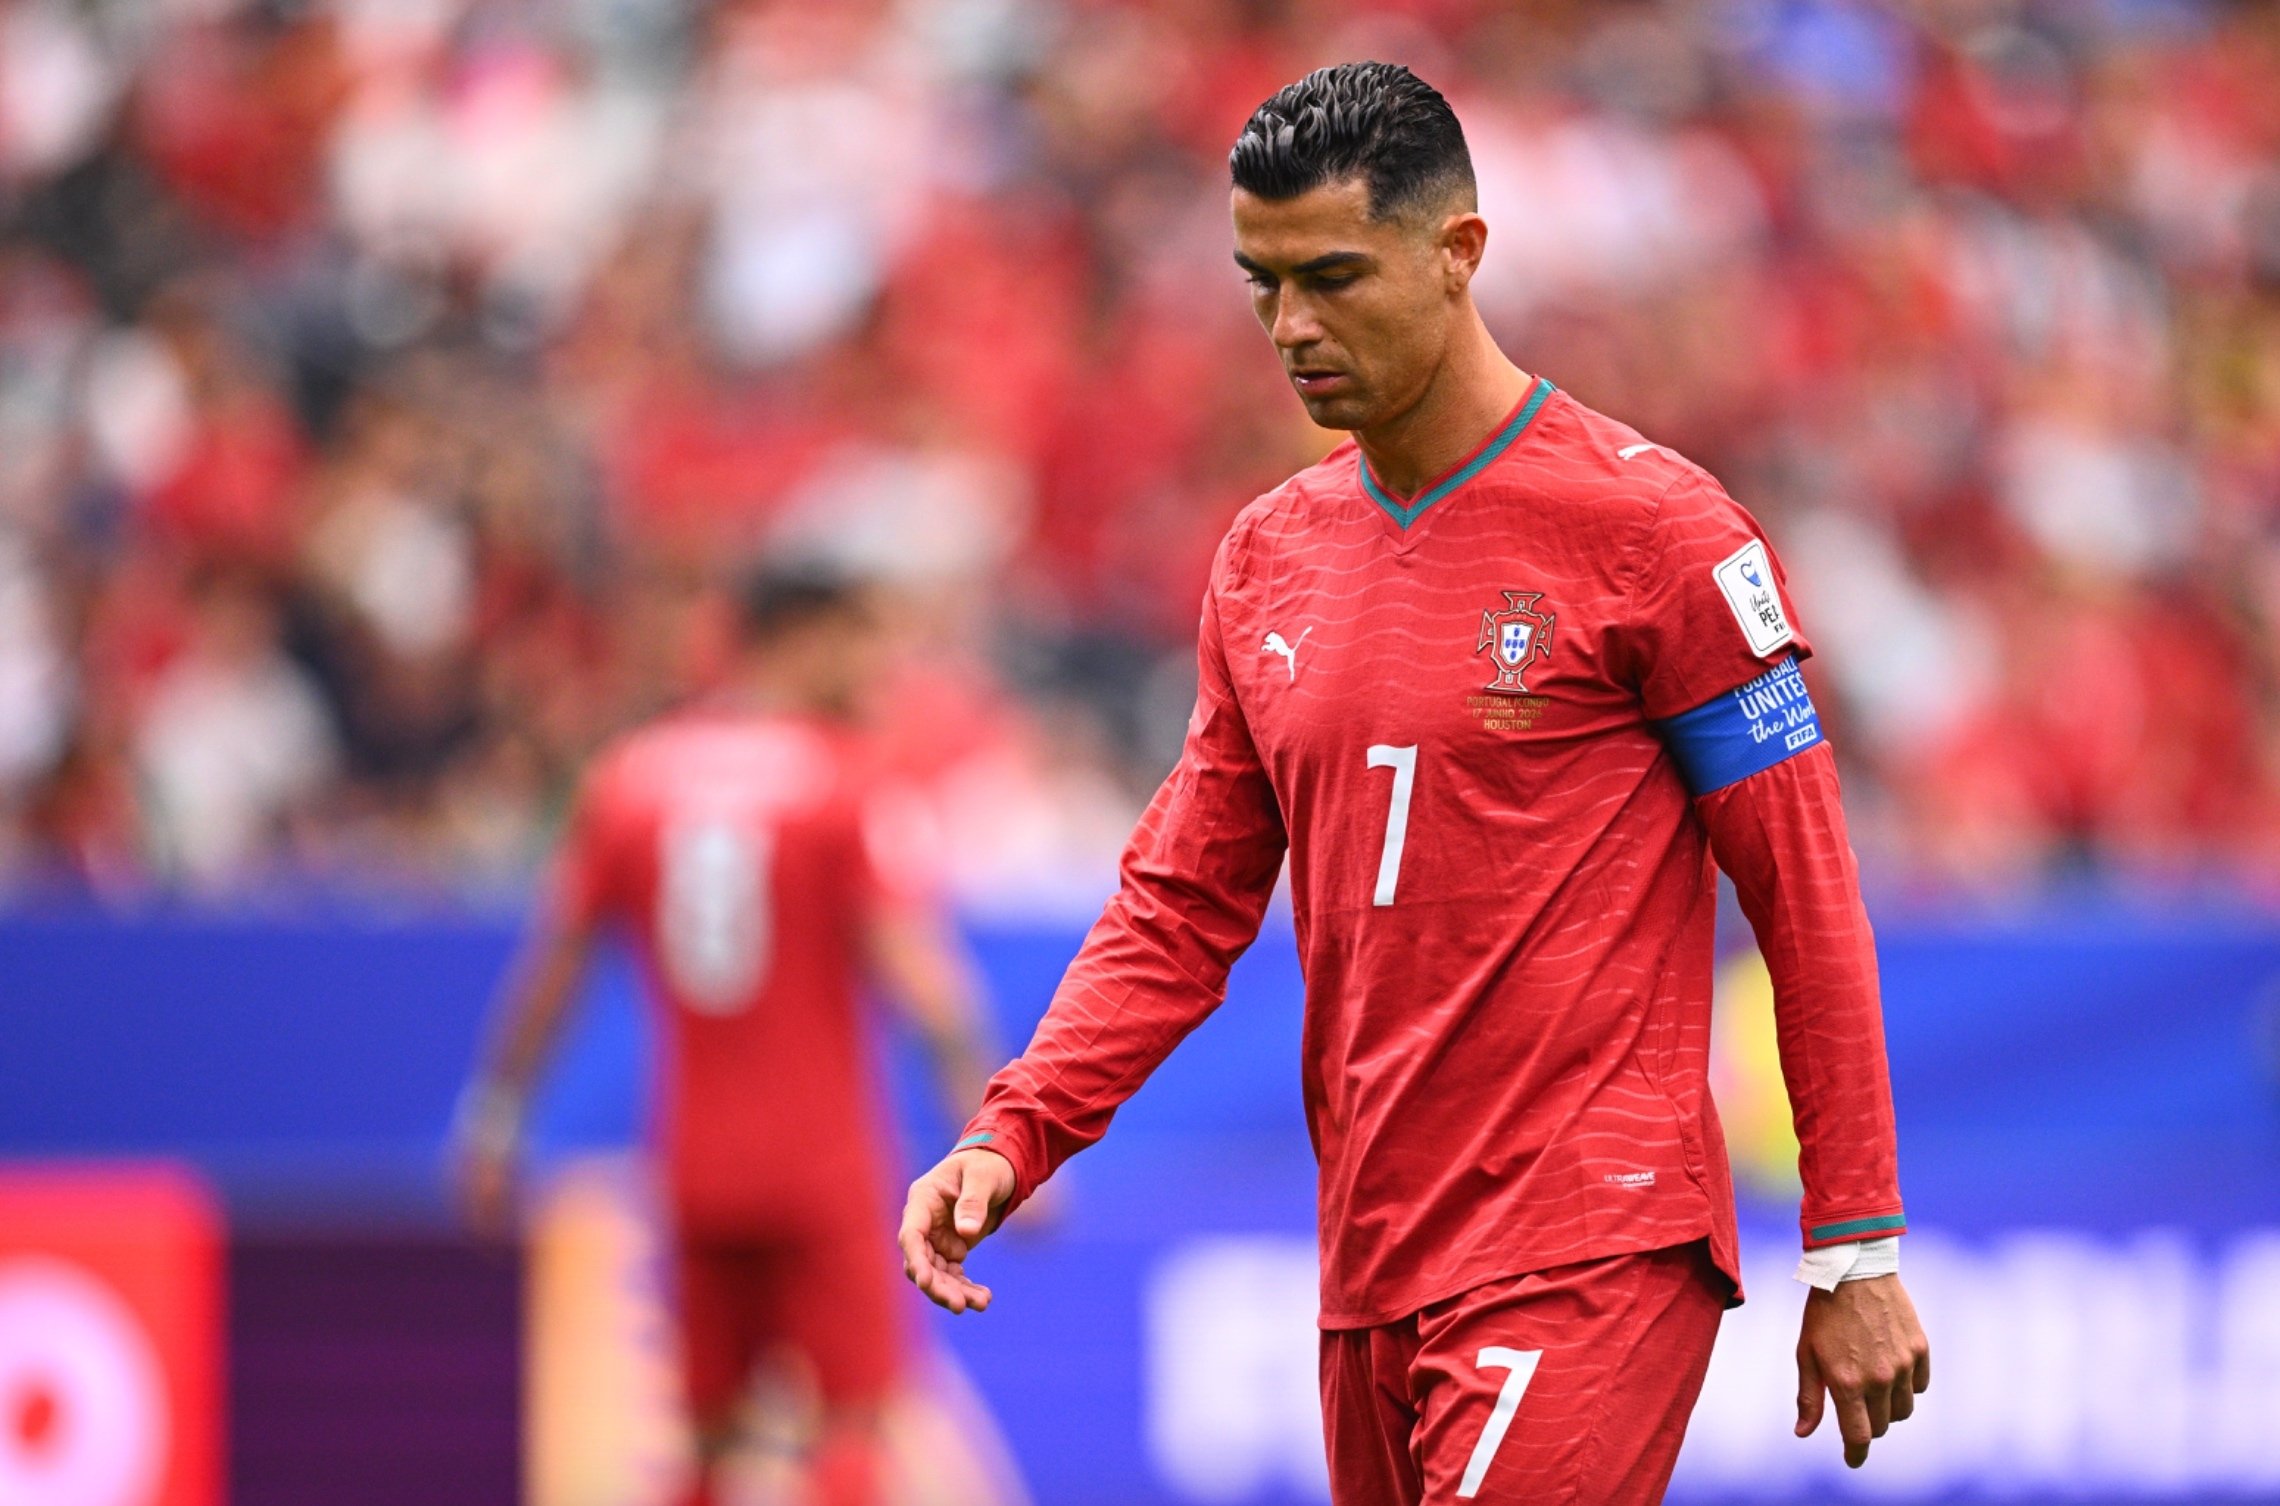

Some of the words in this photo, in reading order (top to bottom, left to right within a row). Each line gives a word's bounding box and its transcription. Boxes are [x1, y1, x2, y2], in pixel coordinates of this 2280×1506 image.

[1738, 671, 1808, 720] UNITES
[1484, 719, 1532, 730] HOUSTON
[1747, 718, 1784, 743] the
[1787, 725, 1815, 747] FIFA
[1366, 744, 1418, 907] 7
[1455, 1345, 1544, 1499] 7
